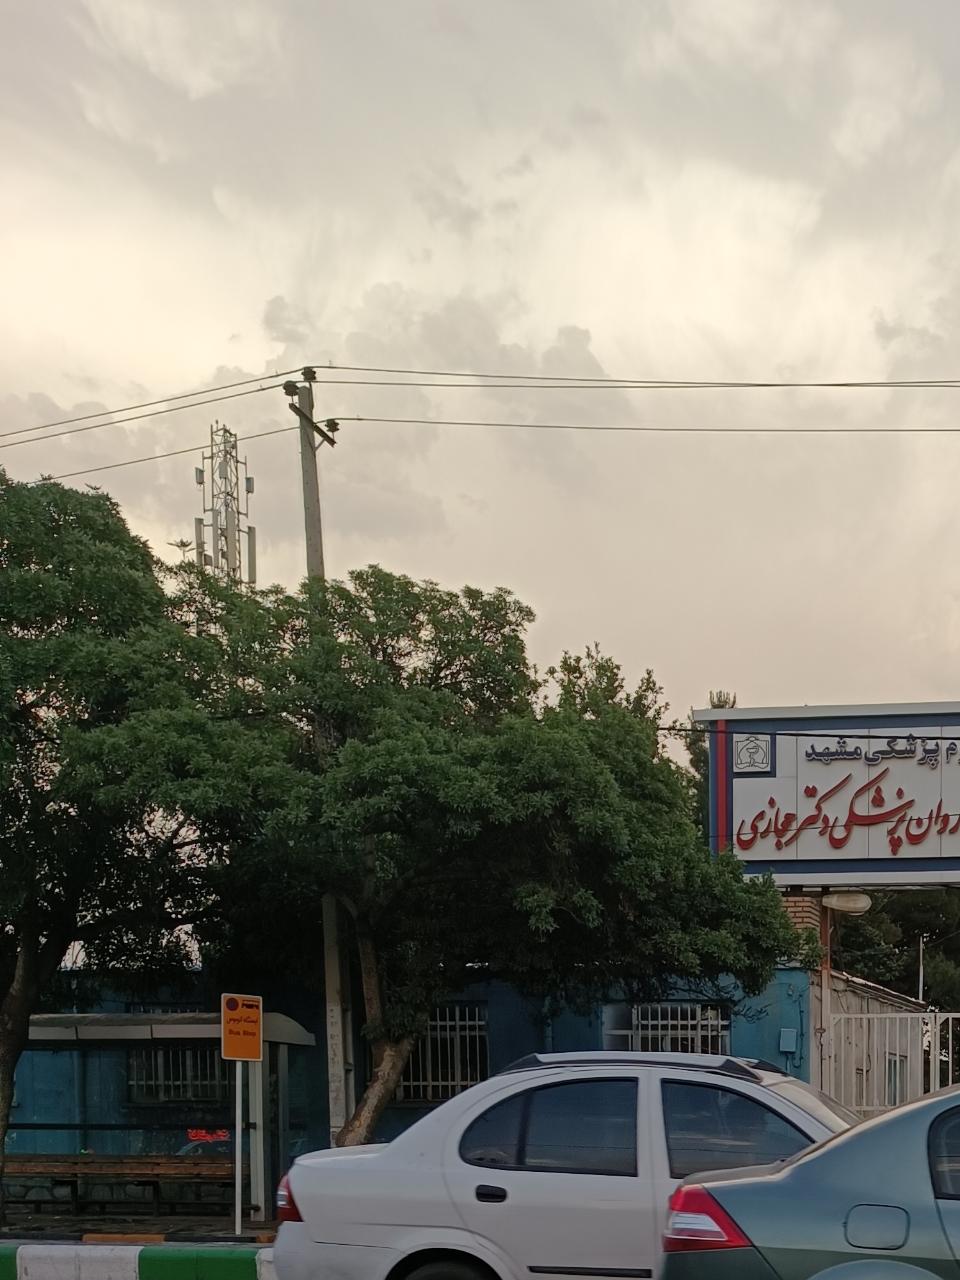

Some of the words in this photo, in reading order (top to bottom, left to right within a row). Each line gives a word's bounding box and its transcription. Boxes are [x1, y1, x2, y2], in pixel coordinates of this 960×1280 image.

[805, 736, 862, 765] مشهد
[864, 734, 940, 769] پزشکی
[736, 796, 798, 850] حجازی
[784, 773, 852, 847] دکتر
